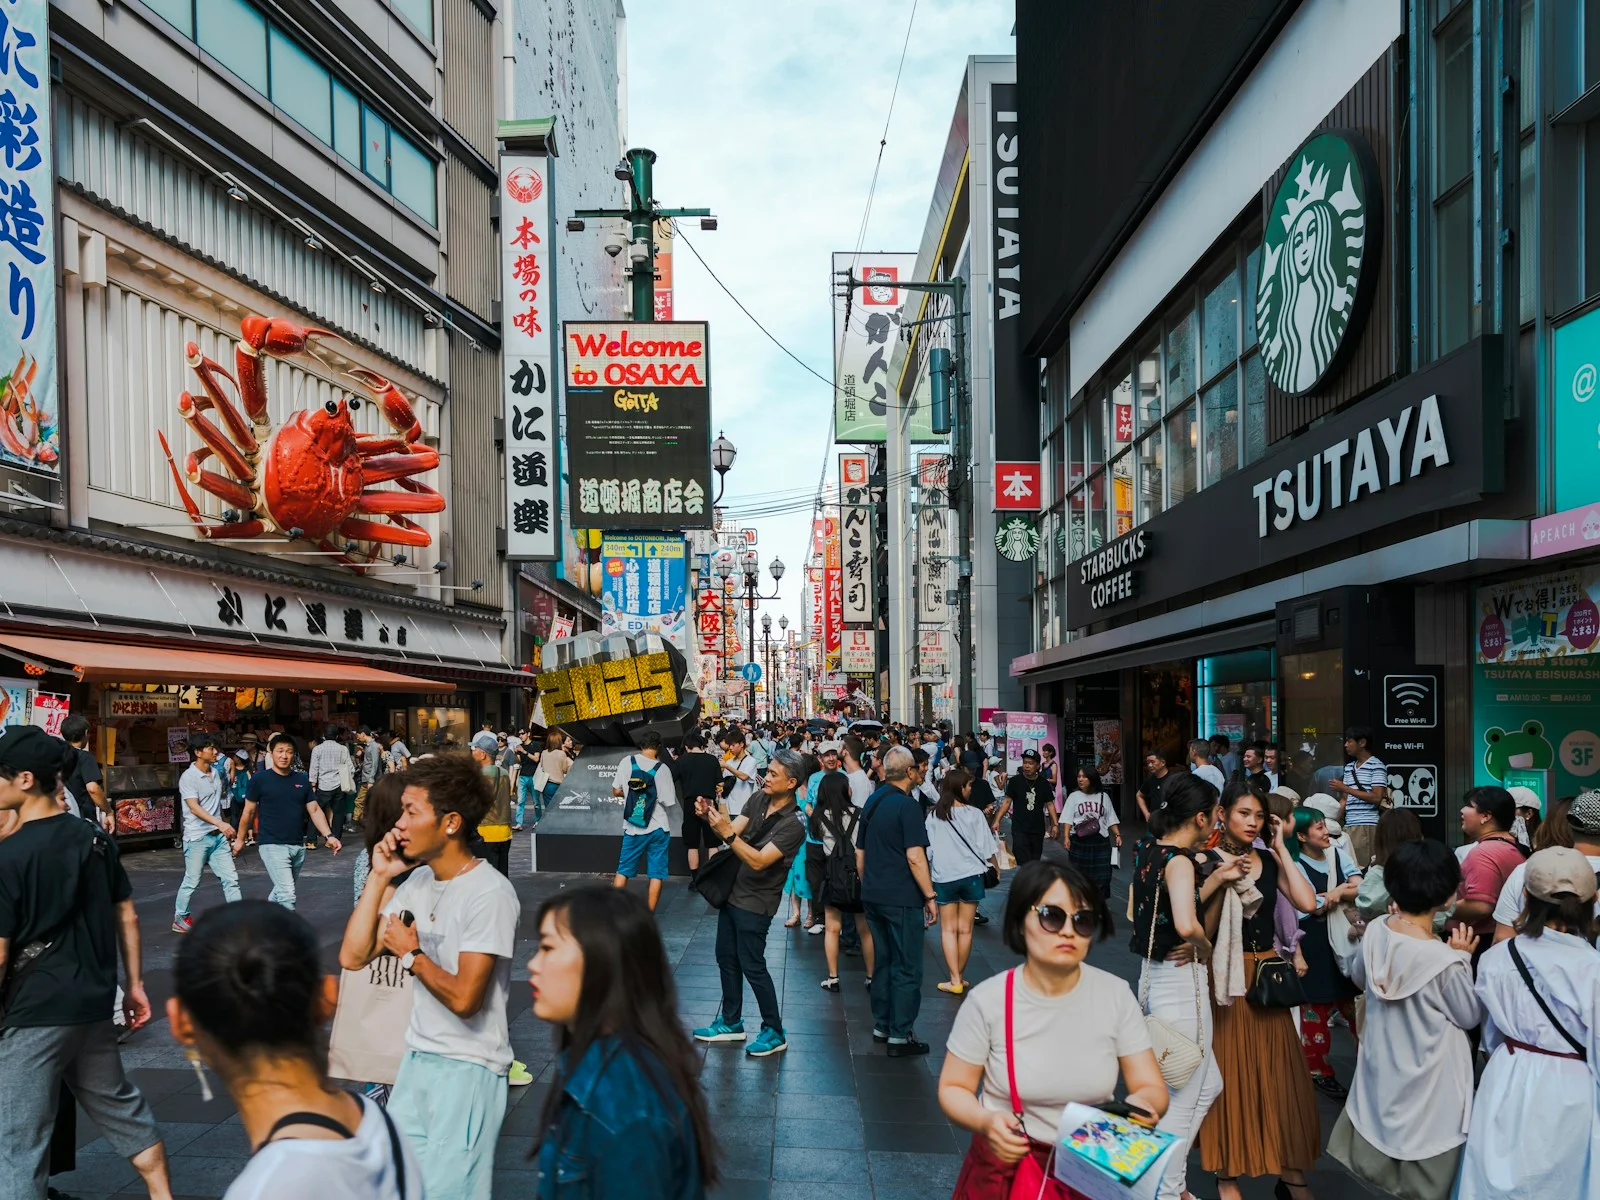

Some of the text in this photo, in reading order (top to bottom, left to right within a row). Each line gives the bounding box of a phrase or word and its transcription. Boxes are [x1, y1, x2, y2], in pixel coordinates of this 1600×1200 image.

[0, 0, 47, 341] に彩造り
[510, 216, 542, 338] 本場の味
[570, 330, 702, 357] Welcome
[571, 363, 704, 385] to OSAKA
[1253, 394, 1450, 538] TSUTAYA
[579, 478, 705, 515] 道頓堀商店会
[1003, 471, 1033, 501] 本
[845, 487, 868, 612] がんこ寿司
[1533, 522, 1576, 546] APEACH
[1081, 530, 1146, 584] STARBUCKS
[829, 570, 841, 643] ツルハドラッグ
[1091, 571, 1133, 609] COFFEE
[1572, 625, 1595, 636] たまる!
[536, 651, 678, 726] 2025
[1484, 670, 1532, 679] TSUTAYA
[1571, 748, 1594, 766] 3F
[1077, 801, 1105, 817] OHIO
